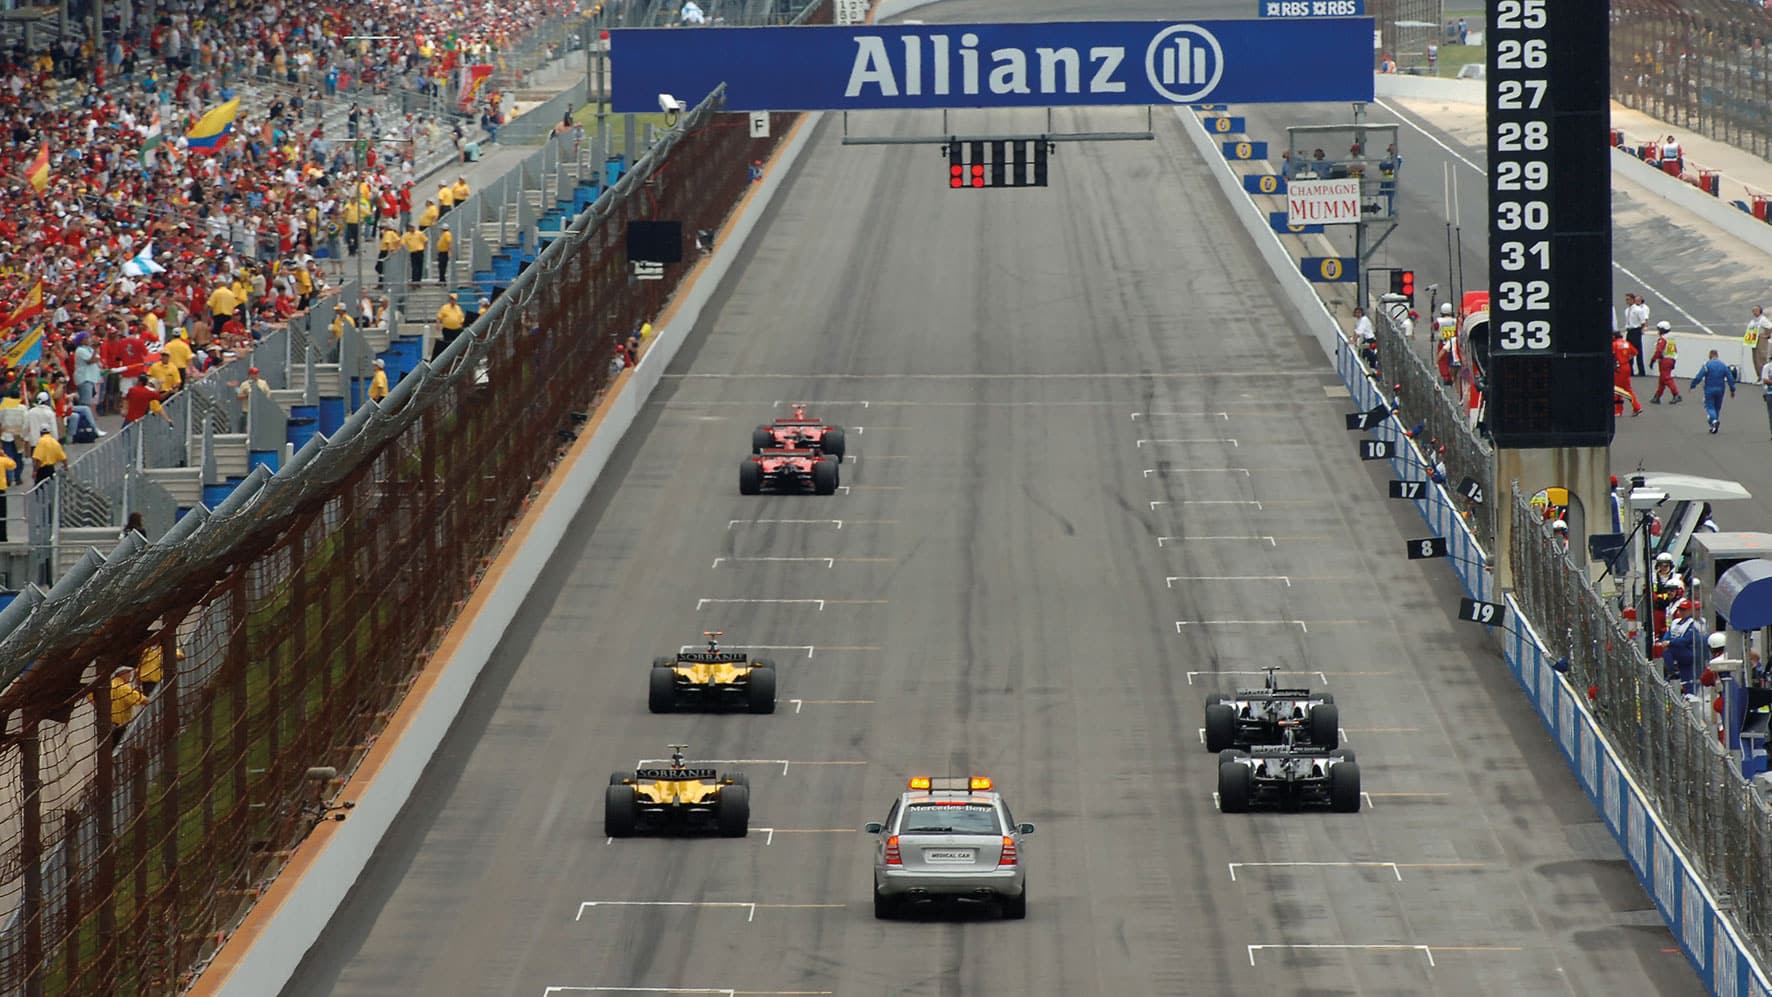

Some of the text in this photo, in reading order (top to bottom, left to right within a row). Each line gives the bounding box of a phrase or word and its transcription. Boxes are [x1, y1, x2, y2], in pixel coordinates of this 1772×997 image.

[1281, 1, 1355, 16] RBS RBS
[1498, 0, 1546, 28] 25
[1498, 40, 1547, 69] 26
[845, 33, 1127, 97] Allianz
[1499, 80, 1547, 109] 27
[755, 119, 764, 132] F
[1498, 121, 1548, 151] 28
[1498, 161, 1548, 190] 29
[1290, 184, 1357, 196] CHAMPAGNE
[1291, 200, 1357, 219] MUMM
[1498, 201, 1548, 230] 30
[1501, 241, 1549, 270] 31
[1500, 281, 1549, 310] 32
[1501, 321, 1550, 349] 33
[1359, 414, 1367, 427] 7
[1368, 442, 1386, 457] 10
[1401, 483, 1419, 497] 17
[1421, 540, 1433, 557] 8
[1472, 602, 1494, 622] 19
[639, 769, 715, 778] SOBRANIE
[910, 805, 992, 813] Mercedes-Benz
